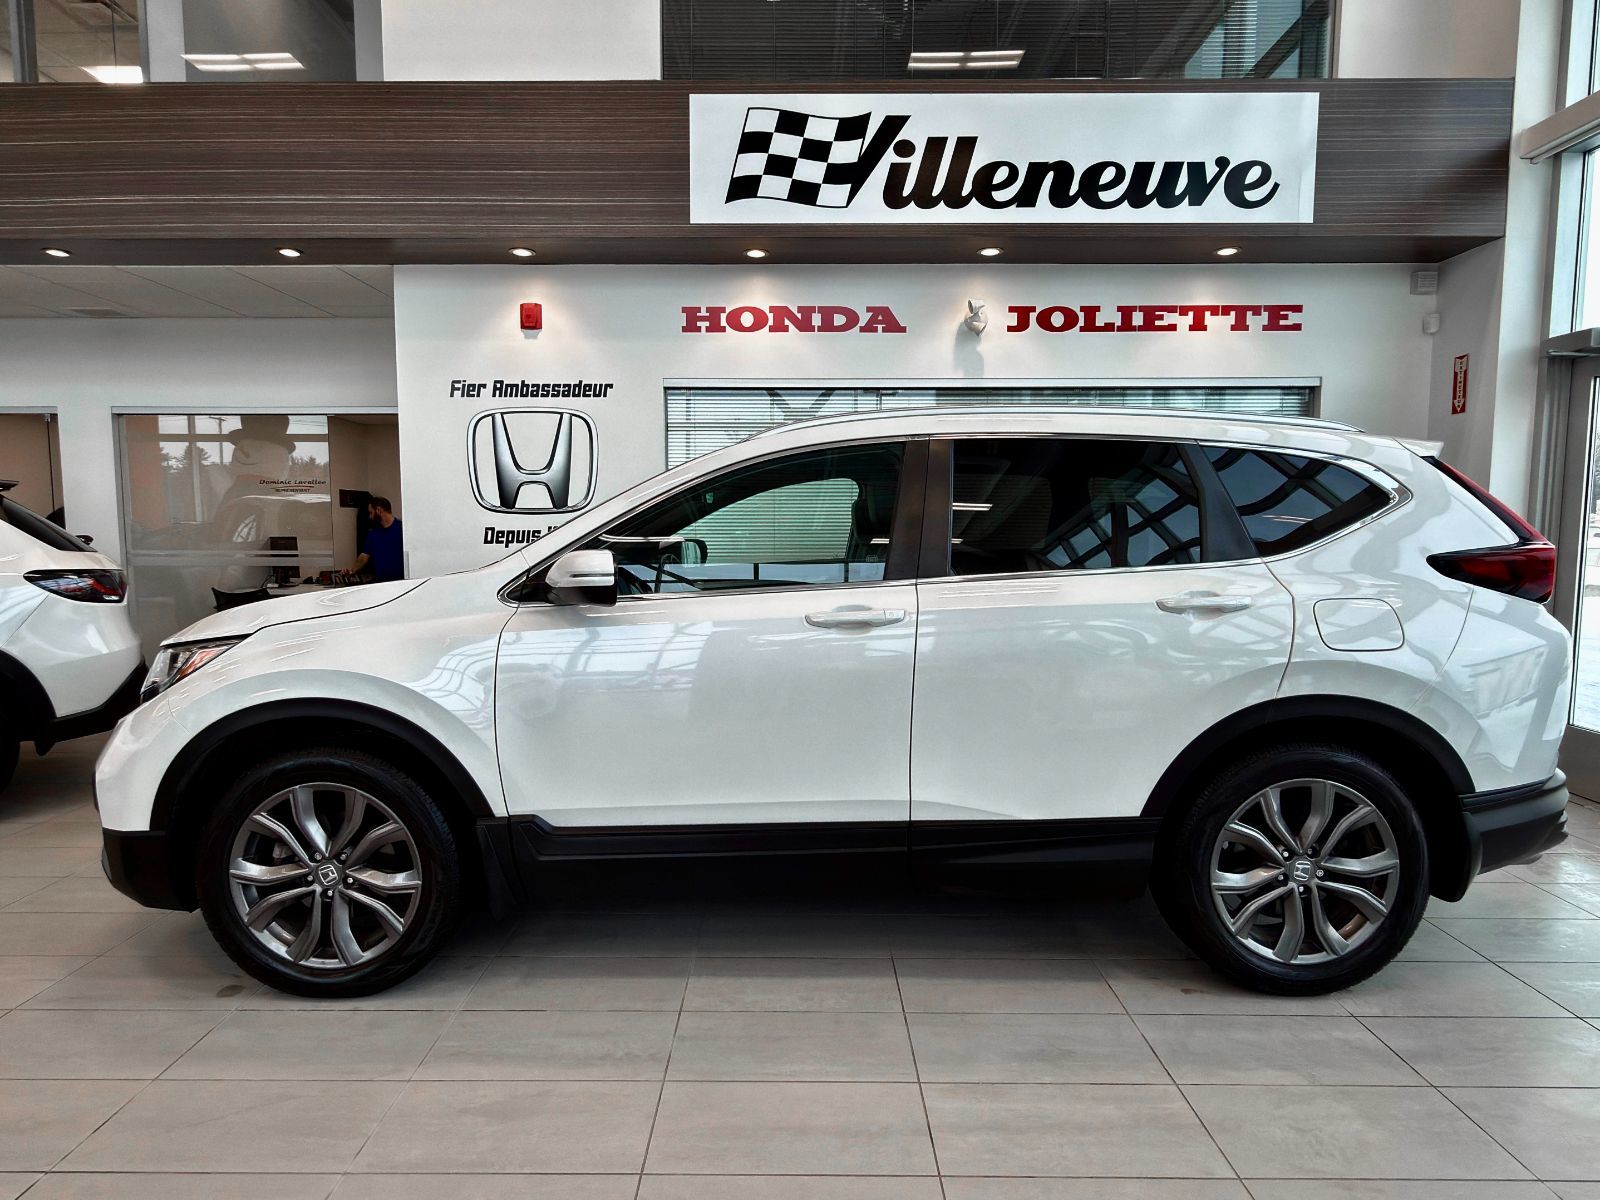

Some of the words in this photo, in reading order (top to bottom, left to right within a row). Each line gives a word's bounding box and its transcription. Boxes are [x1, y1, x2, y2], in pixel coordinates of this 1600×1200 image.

[844, 111, 1280, 210] Villeneuve
[682, 305, 906, 333] HONDA
[1007, 304, 1304, 333] JOLIETTE
[450, 379, 487, 398] Fier
[491, 379, 614, 398] Ambassadeur
[483, 526, 542, 549] Depuis
